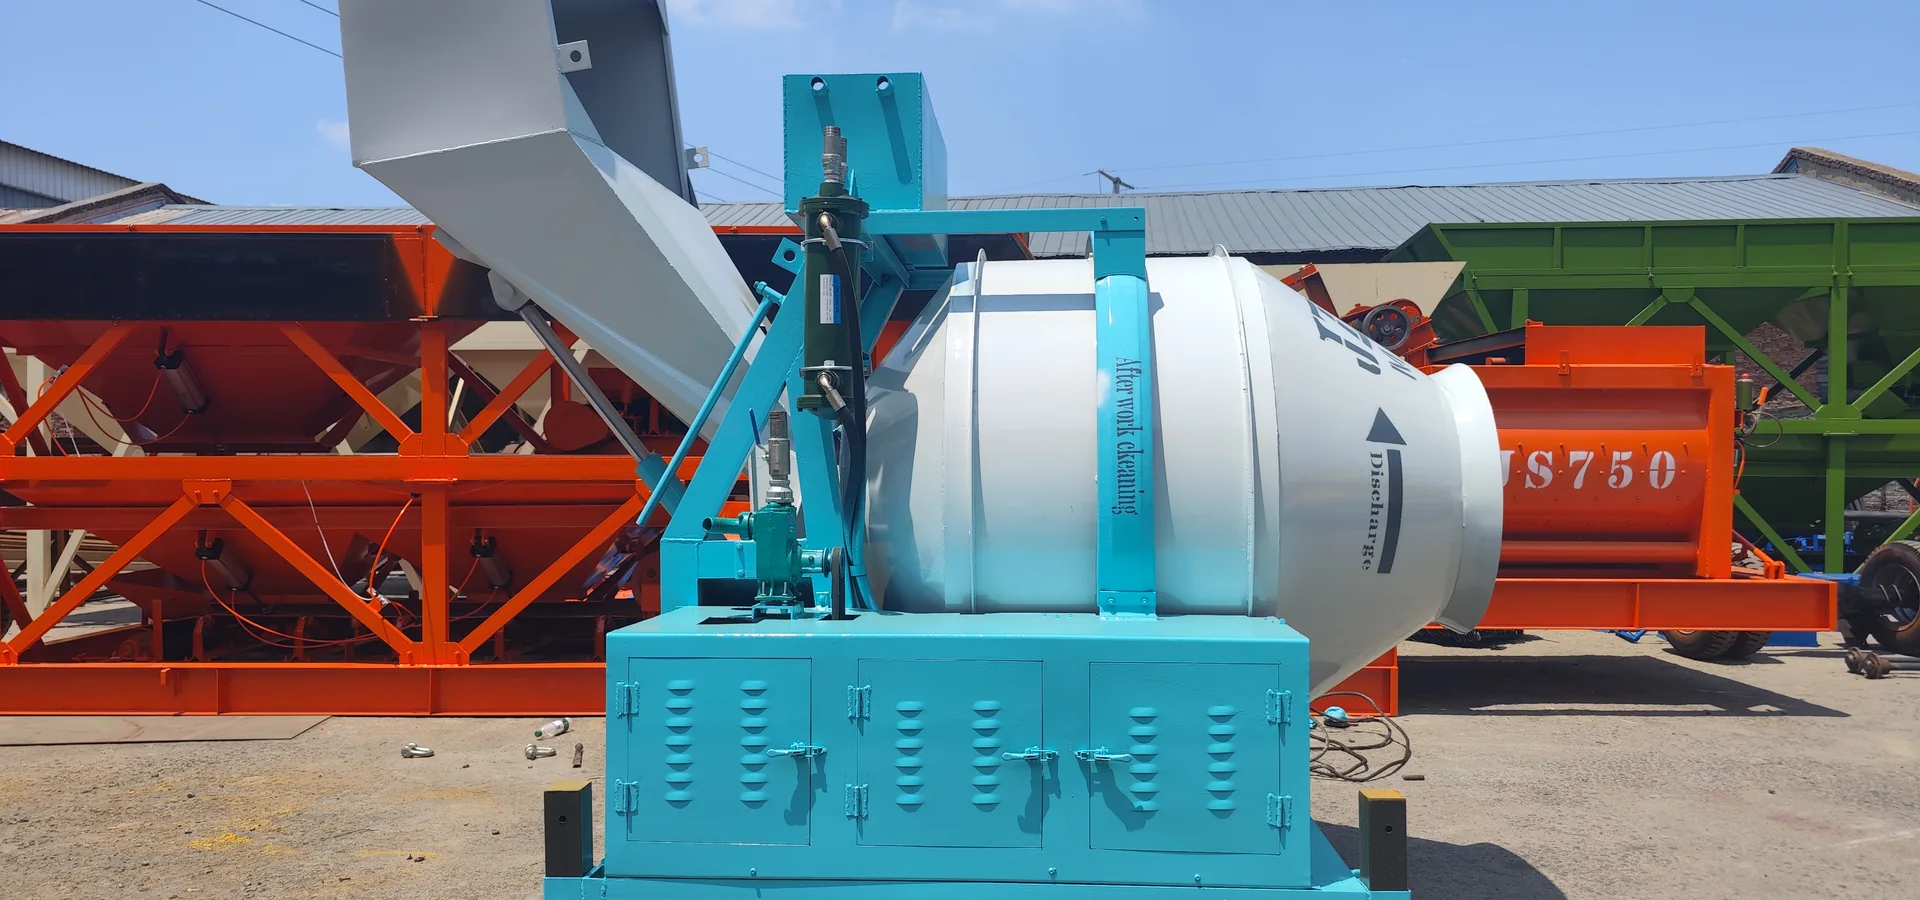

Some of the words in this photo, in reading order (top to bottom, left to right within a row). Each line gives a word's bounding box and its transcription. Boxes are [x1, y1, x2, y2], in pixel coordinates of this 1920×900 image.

[1115, 356, 1141, 394] After
[1116, 397, 1143, 437] work
[1361, 451, 1384, 571] Discharge
